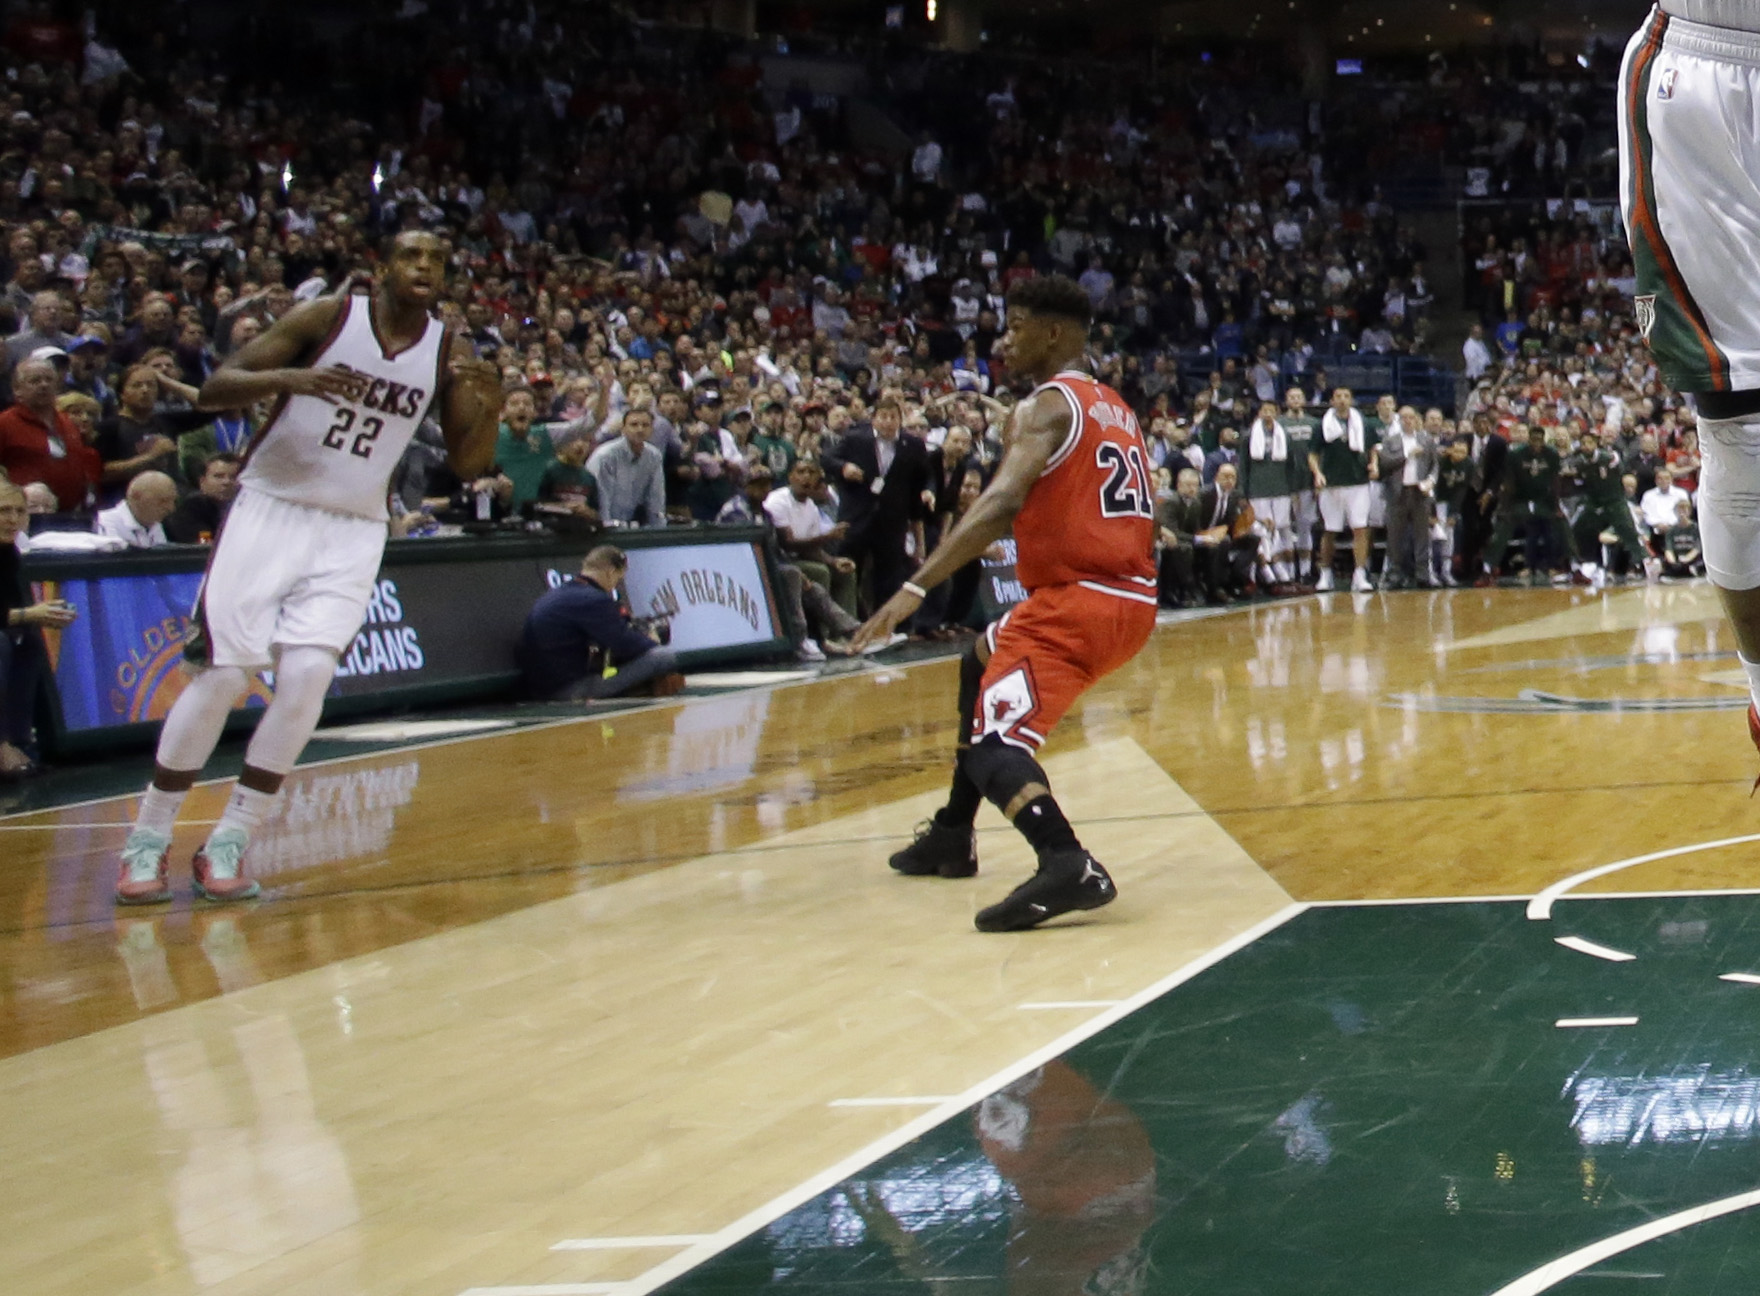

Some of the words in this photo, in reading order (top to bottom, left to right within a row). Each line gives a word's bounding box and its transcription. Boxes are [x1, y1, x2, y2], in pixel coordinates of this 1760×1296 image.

[323, 407, 385, 459] 22
[1095, 440, 1153, 520] 21
[680, 569, 759, 631] ORLEANS
